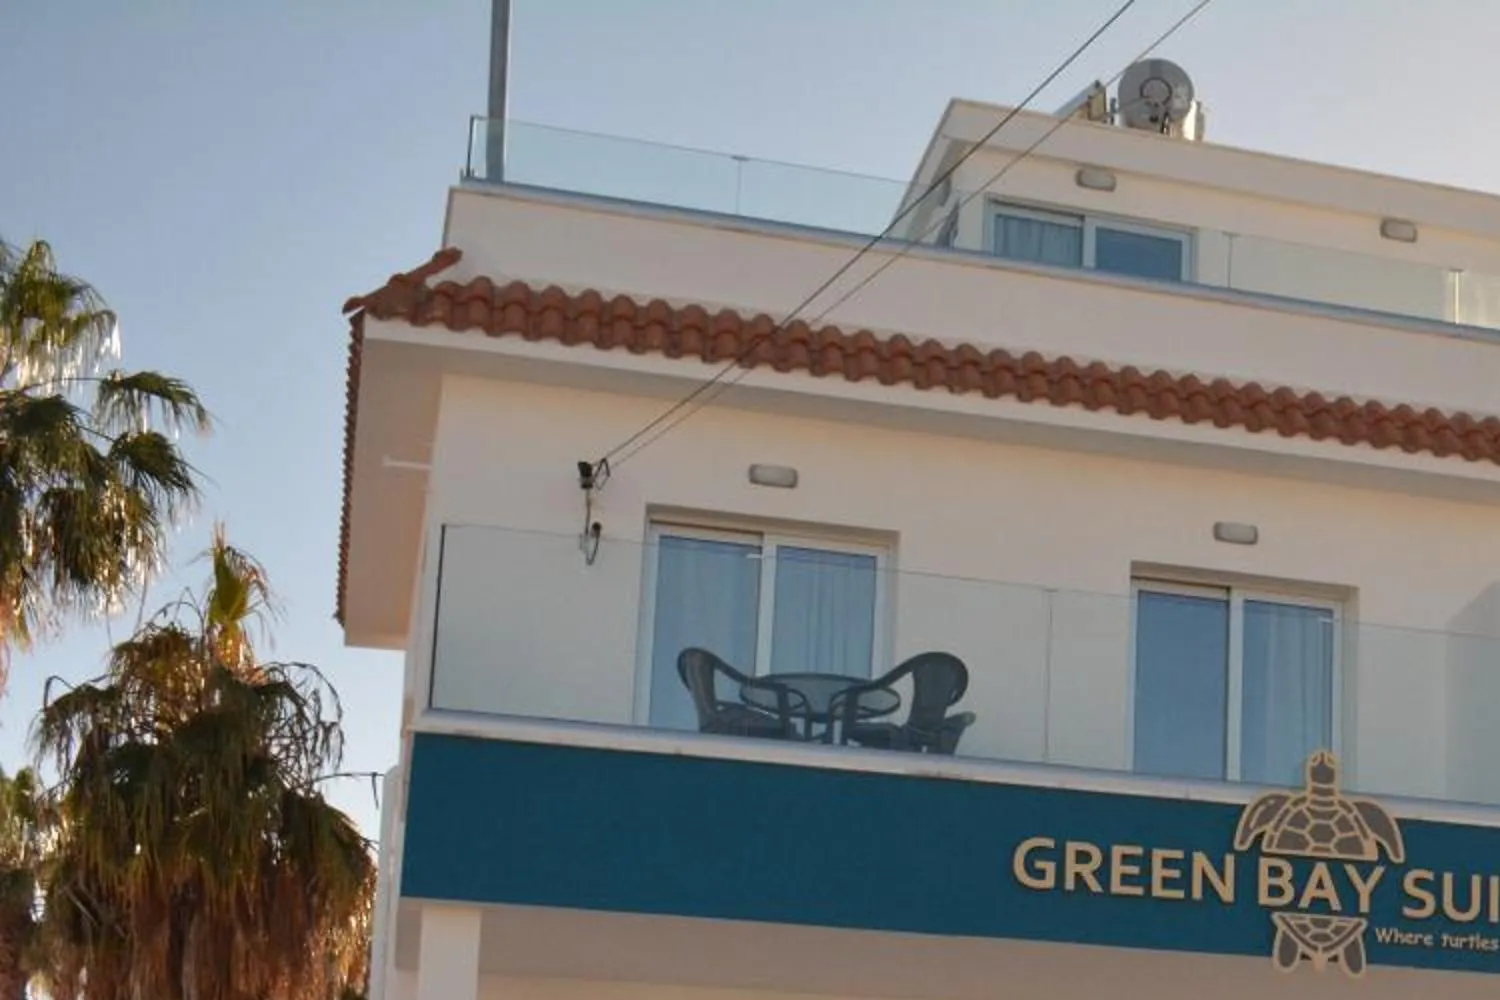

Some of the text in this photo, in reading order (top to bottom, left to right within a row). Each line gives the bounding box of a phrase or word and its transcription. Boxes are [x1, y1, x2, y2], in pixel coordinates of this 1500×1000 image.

[1013, 836, 1235, 903] GREEN
[1258, 857, 1386, 913] BAY
[1376, 927, 1433, 947] Where
[1441, 932, 1499, 951] turtles
